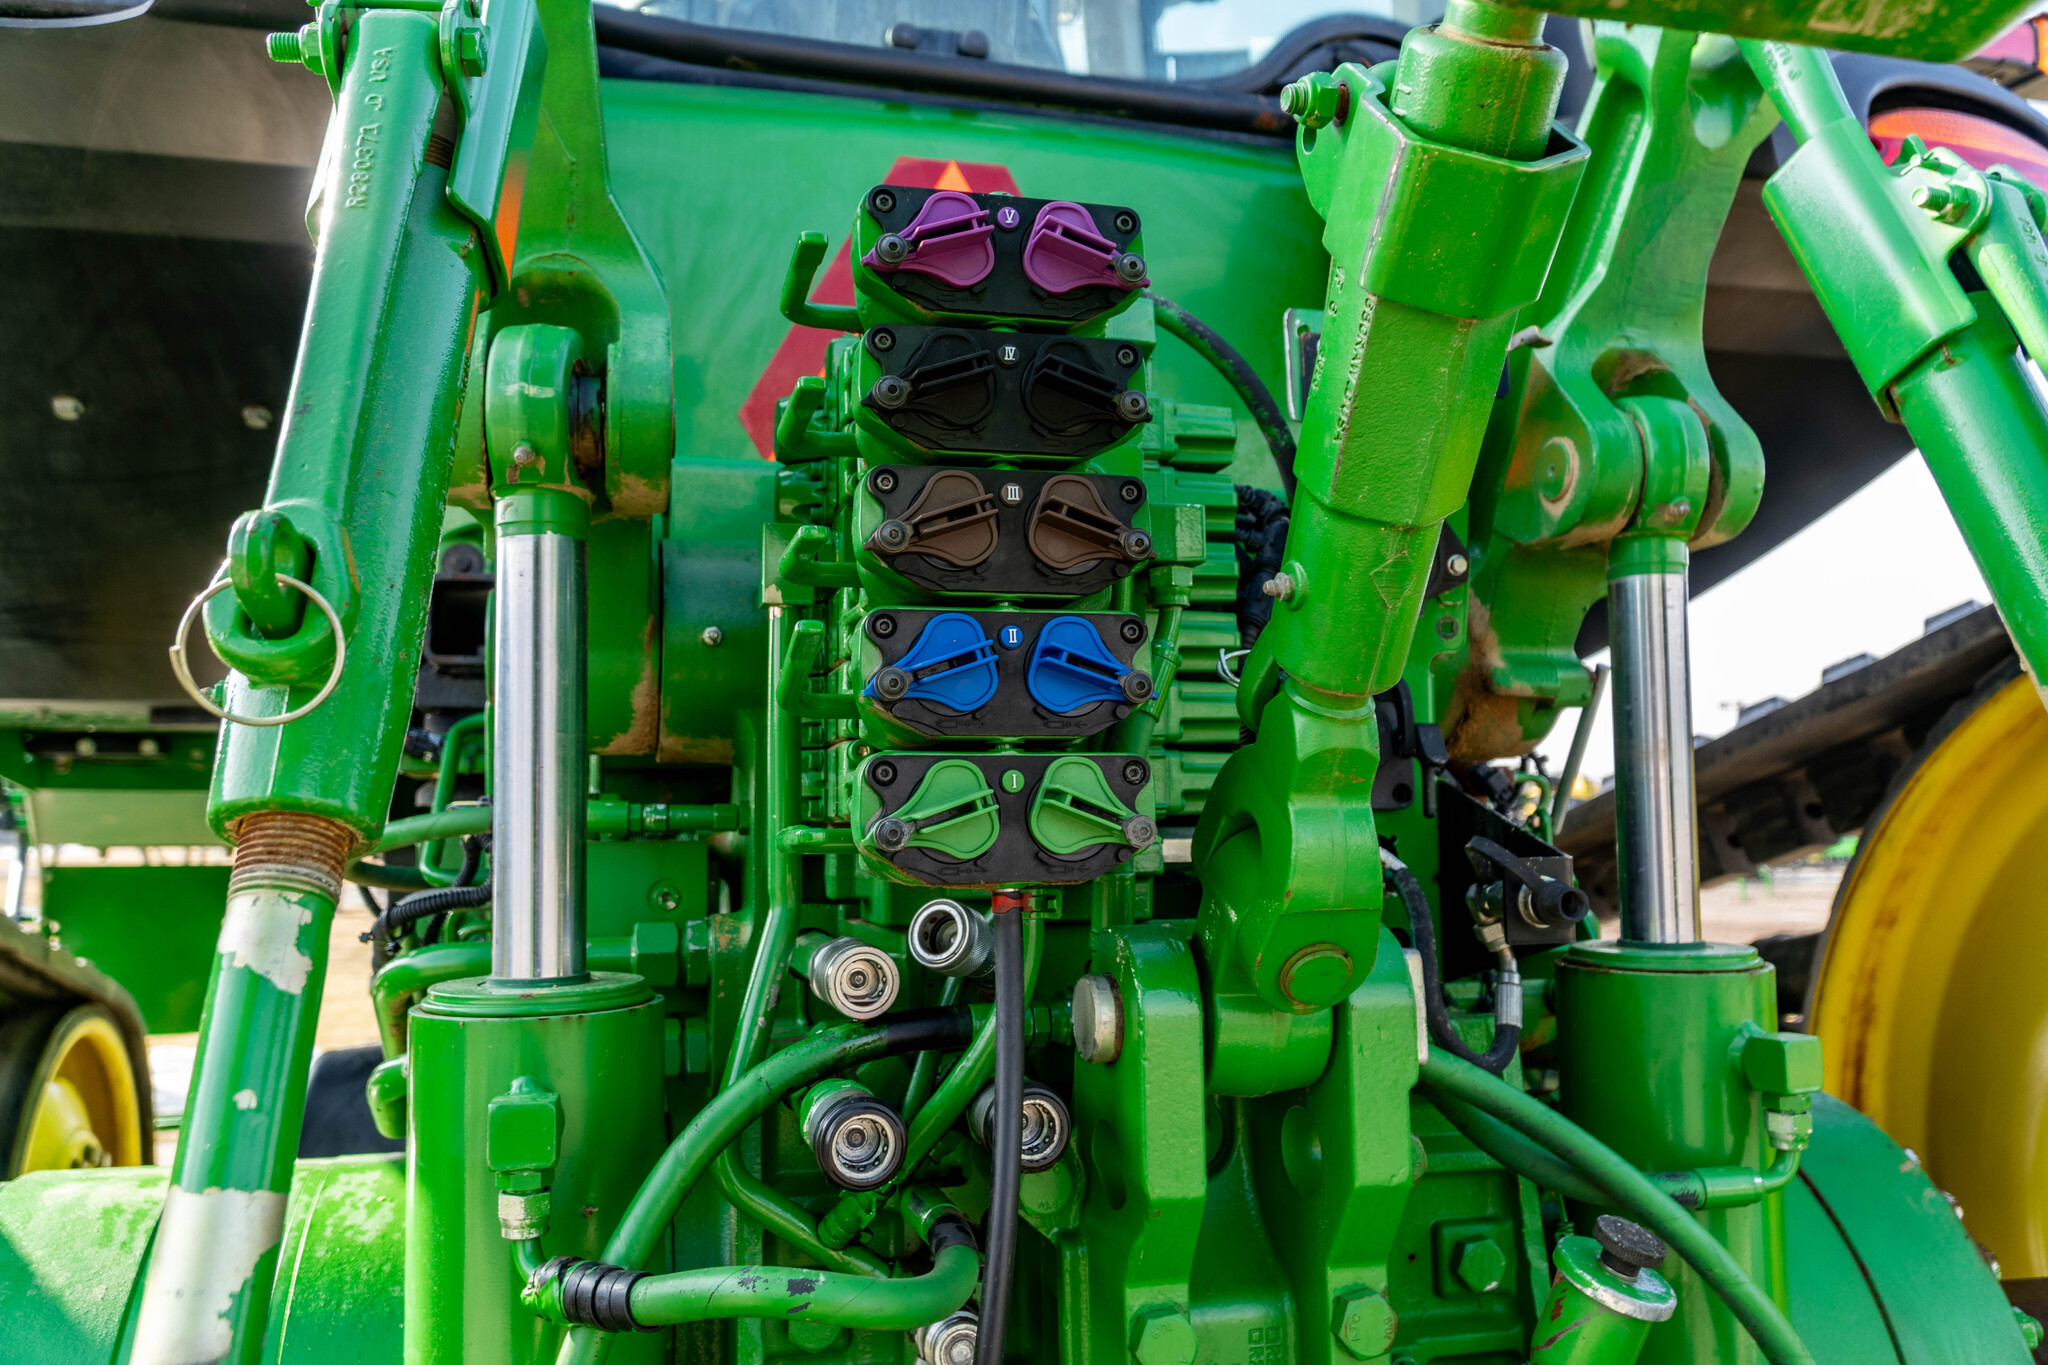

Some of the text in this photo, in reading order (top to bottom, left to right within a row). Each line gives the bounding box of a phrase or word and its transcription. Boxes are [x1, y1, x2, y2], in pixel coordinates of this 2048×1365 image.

[369, 47, 394, 83] USA
[1004, 209, 1016, 224] V
[1004, 346, 1016, 361] IV
[1007, 485, 1020, 501] III
[1008, 628, 1018, 644] II
